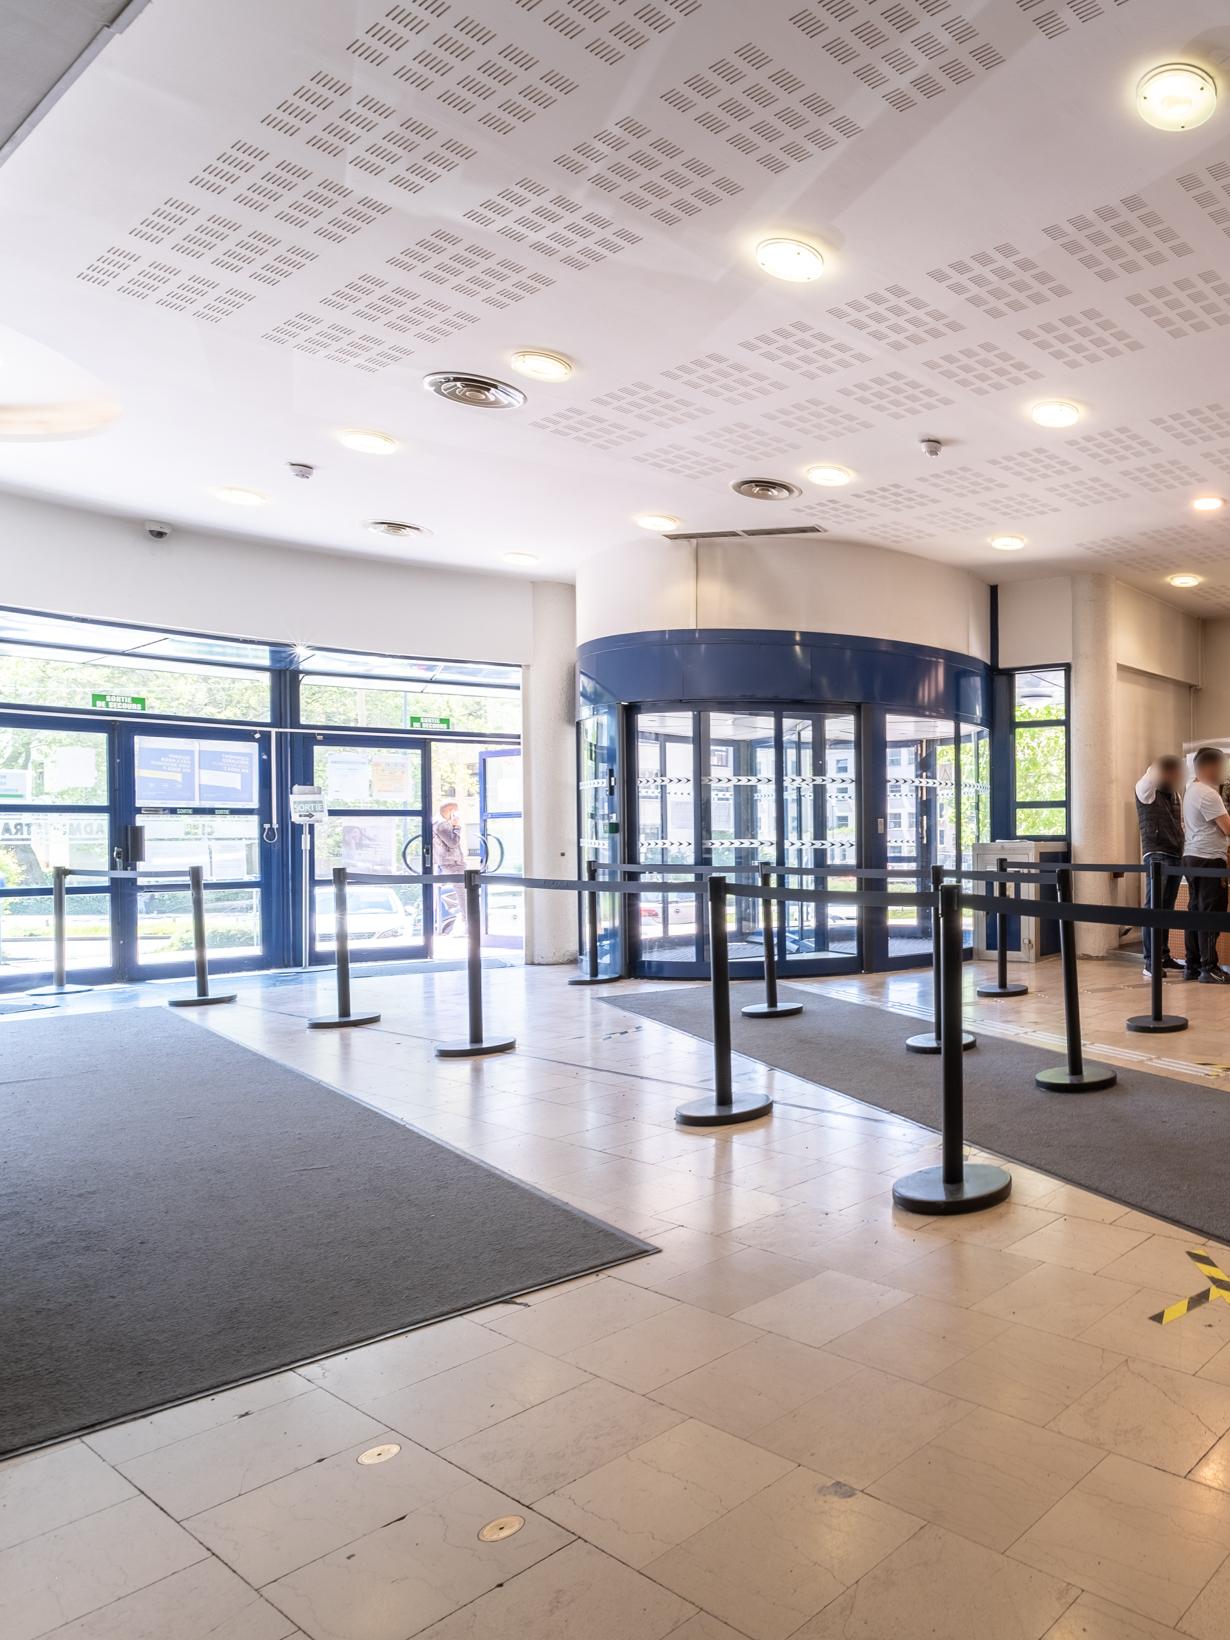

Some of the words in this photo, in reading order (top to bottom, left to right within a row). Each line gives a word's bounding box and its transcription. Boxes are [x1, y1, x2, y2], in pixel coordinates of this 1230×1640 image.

[106, 695, 132, 703] SORTIE
[108, 702, 142, 710] SECOURS
[294, 803, 324, 812] SORTIE
